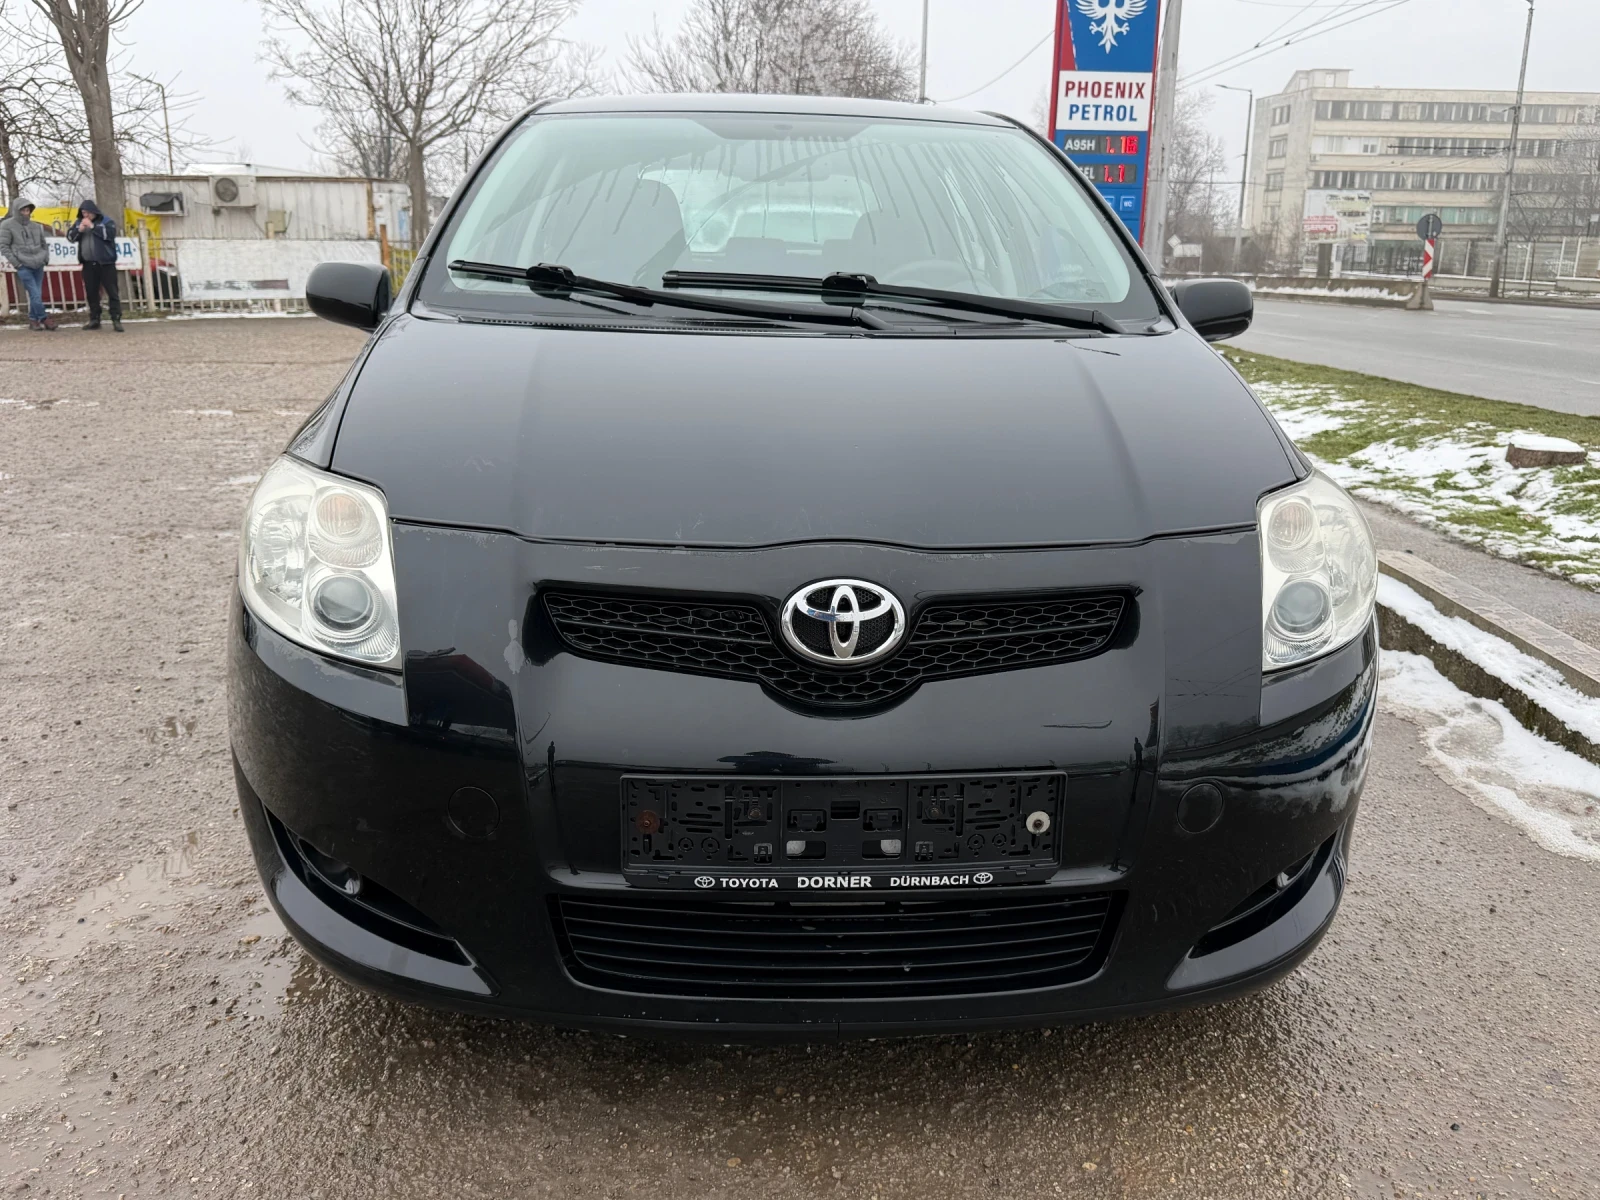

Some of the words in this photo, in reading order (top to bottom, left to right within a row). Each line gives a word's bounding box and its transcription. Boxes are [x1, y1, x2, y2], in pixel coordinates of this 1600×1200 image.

[1064, 80, 1146, 99] PHOENIX
[1068, 103, 1138, 122] PETROL
[1064, 139, 1096, 151] A95H
[720, 878, 779, 888] TOYOTA
[797, 876, 873, 888] DORNER
[889, 874, 970, 887] DÜRNBACH
